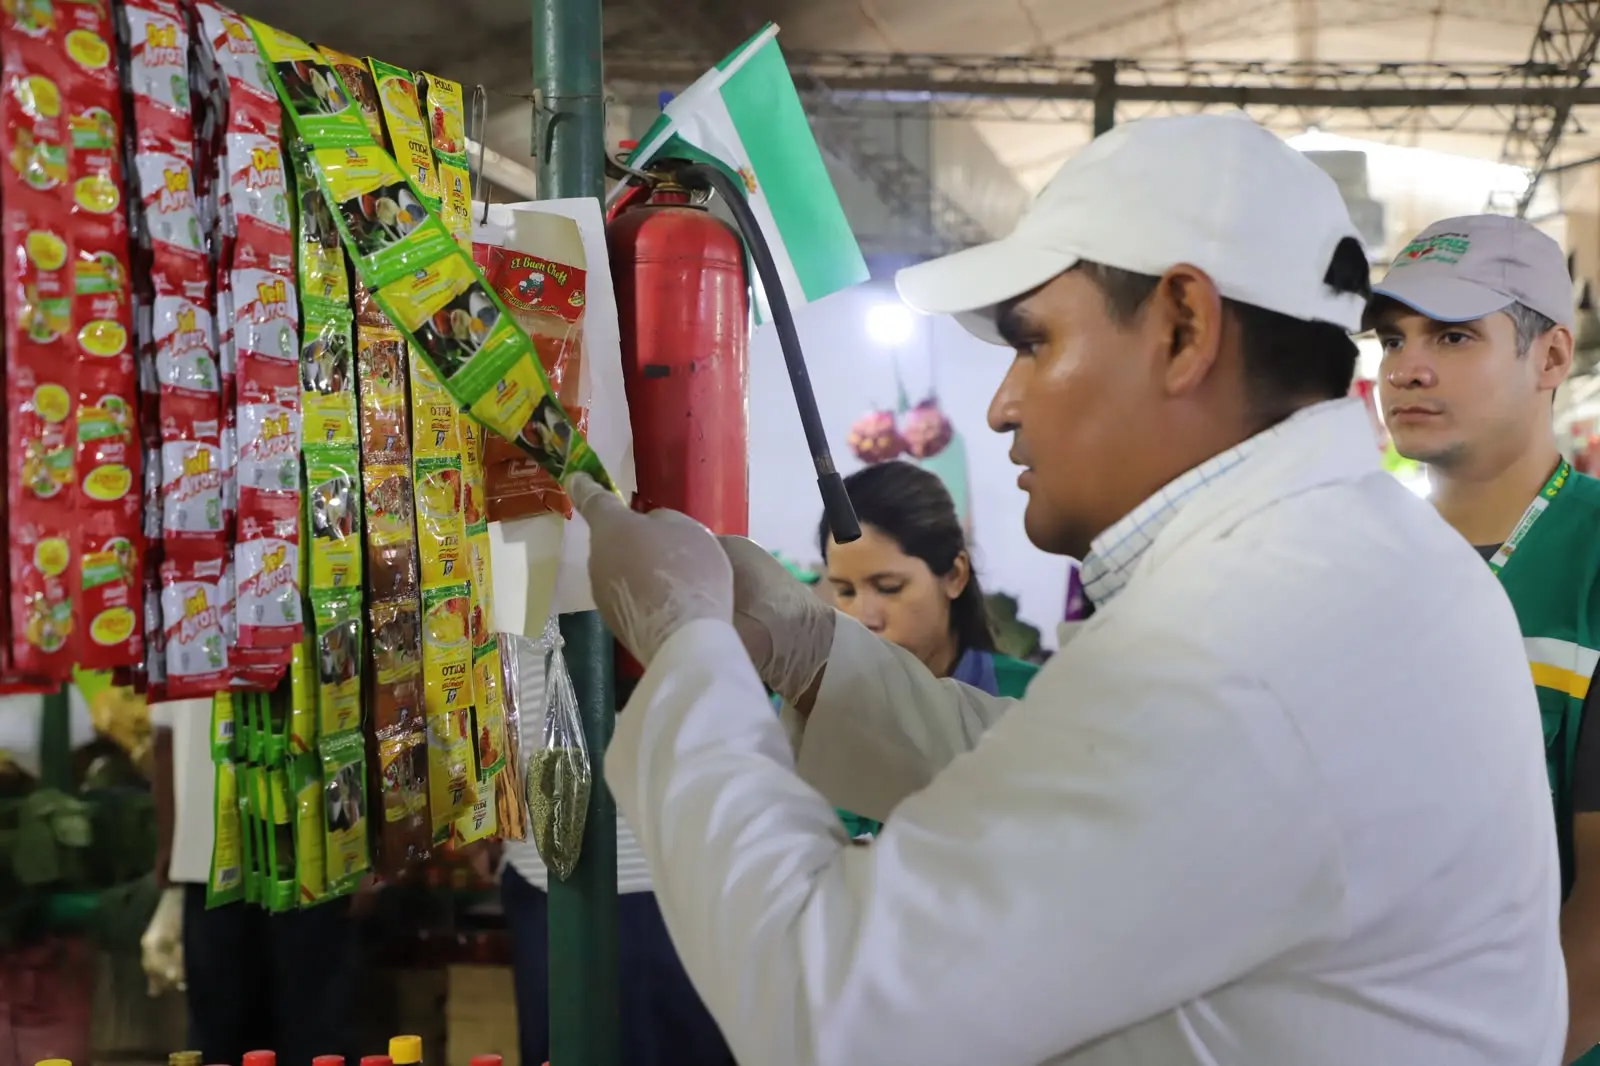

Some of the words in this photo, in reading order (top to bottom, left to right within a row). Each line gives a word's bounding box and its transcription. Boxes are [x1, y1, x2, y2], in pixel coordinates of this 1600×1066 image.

[434, 77, 454, 93] POLLO
[408, 140, 429, 155] POLLO
[511, 257, 522, 270] El
[523, 256, 546, 273] Buen
[547, 262, 569, 287] Cheff
[442, 662, 466, 677] POLLO
